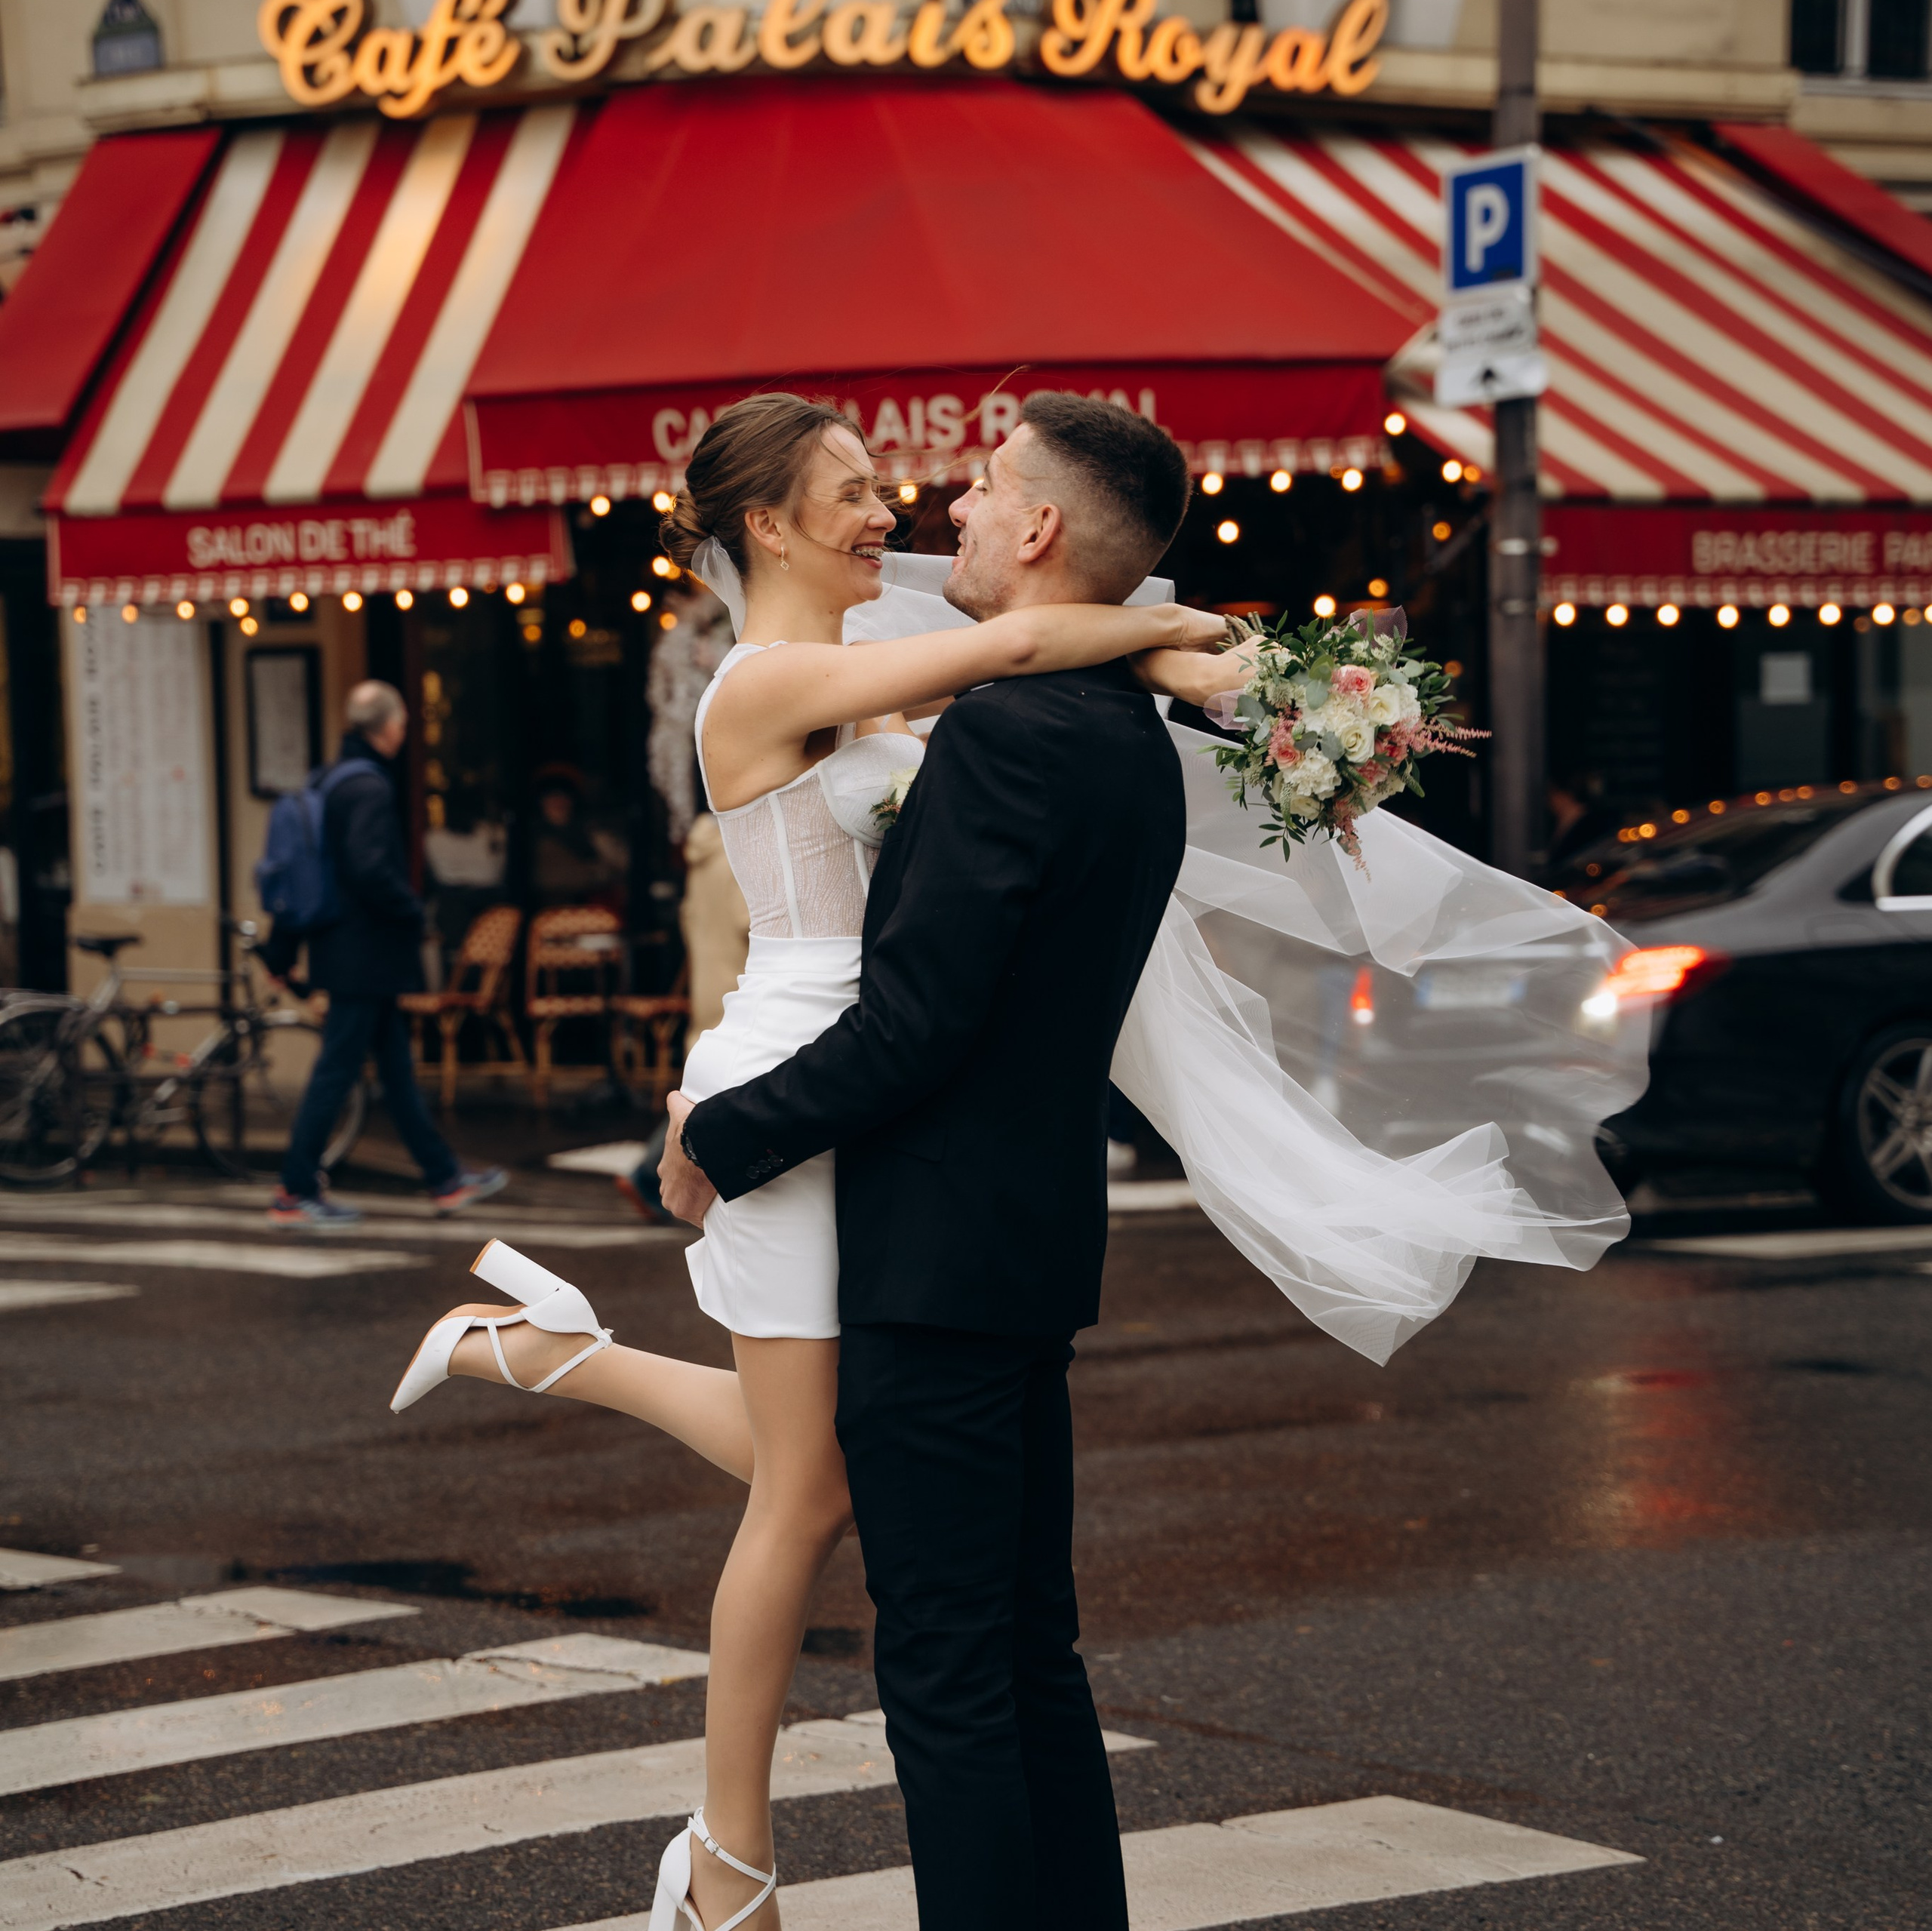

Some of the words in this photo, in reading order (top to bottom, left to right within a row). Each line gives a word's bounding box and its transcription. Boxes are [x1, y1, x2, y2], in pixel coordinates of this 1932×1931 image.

[257, 0, 521, 119] Café
[540, 0, 1014, 80] Palais
[1040, 0, 1389, 115] Royal
[1465, 183, 1509, 272] P
[842, 391, 967, 452] AIS
[187, 521, 296, 567] SALON
[298, 518, 349, 561] DE
[349, 508, 417, 559] THÉ
[1693, 531, 1875, 573] BRASSERIE
